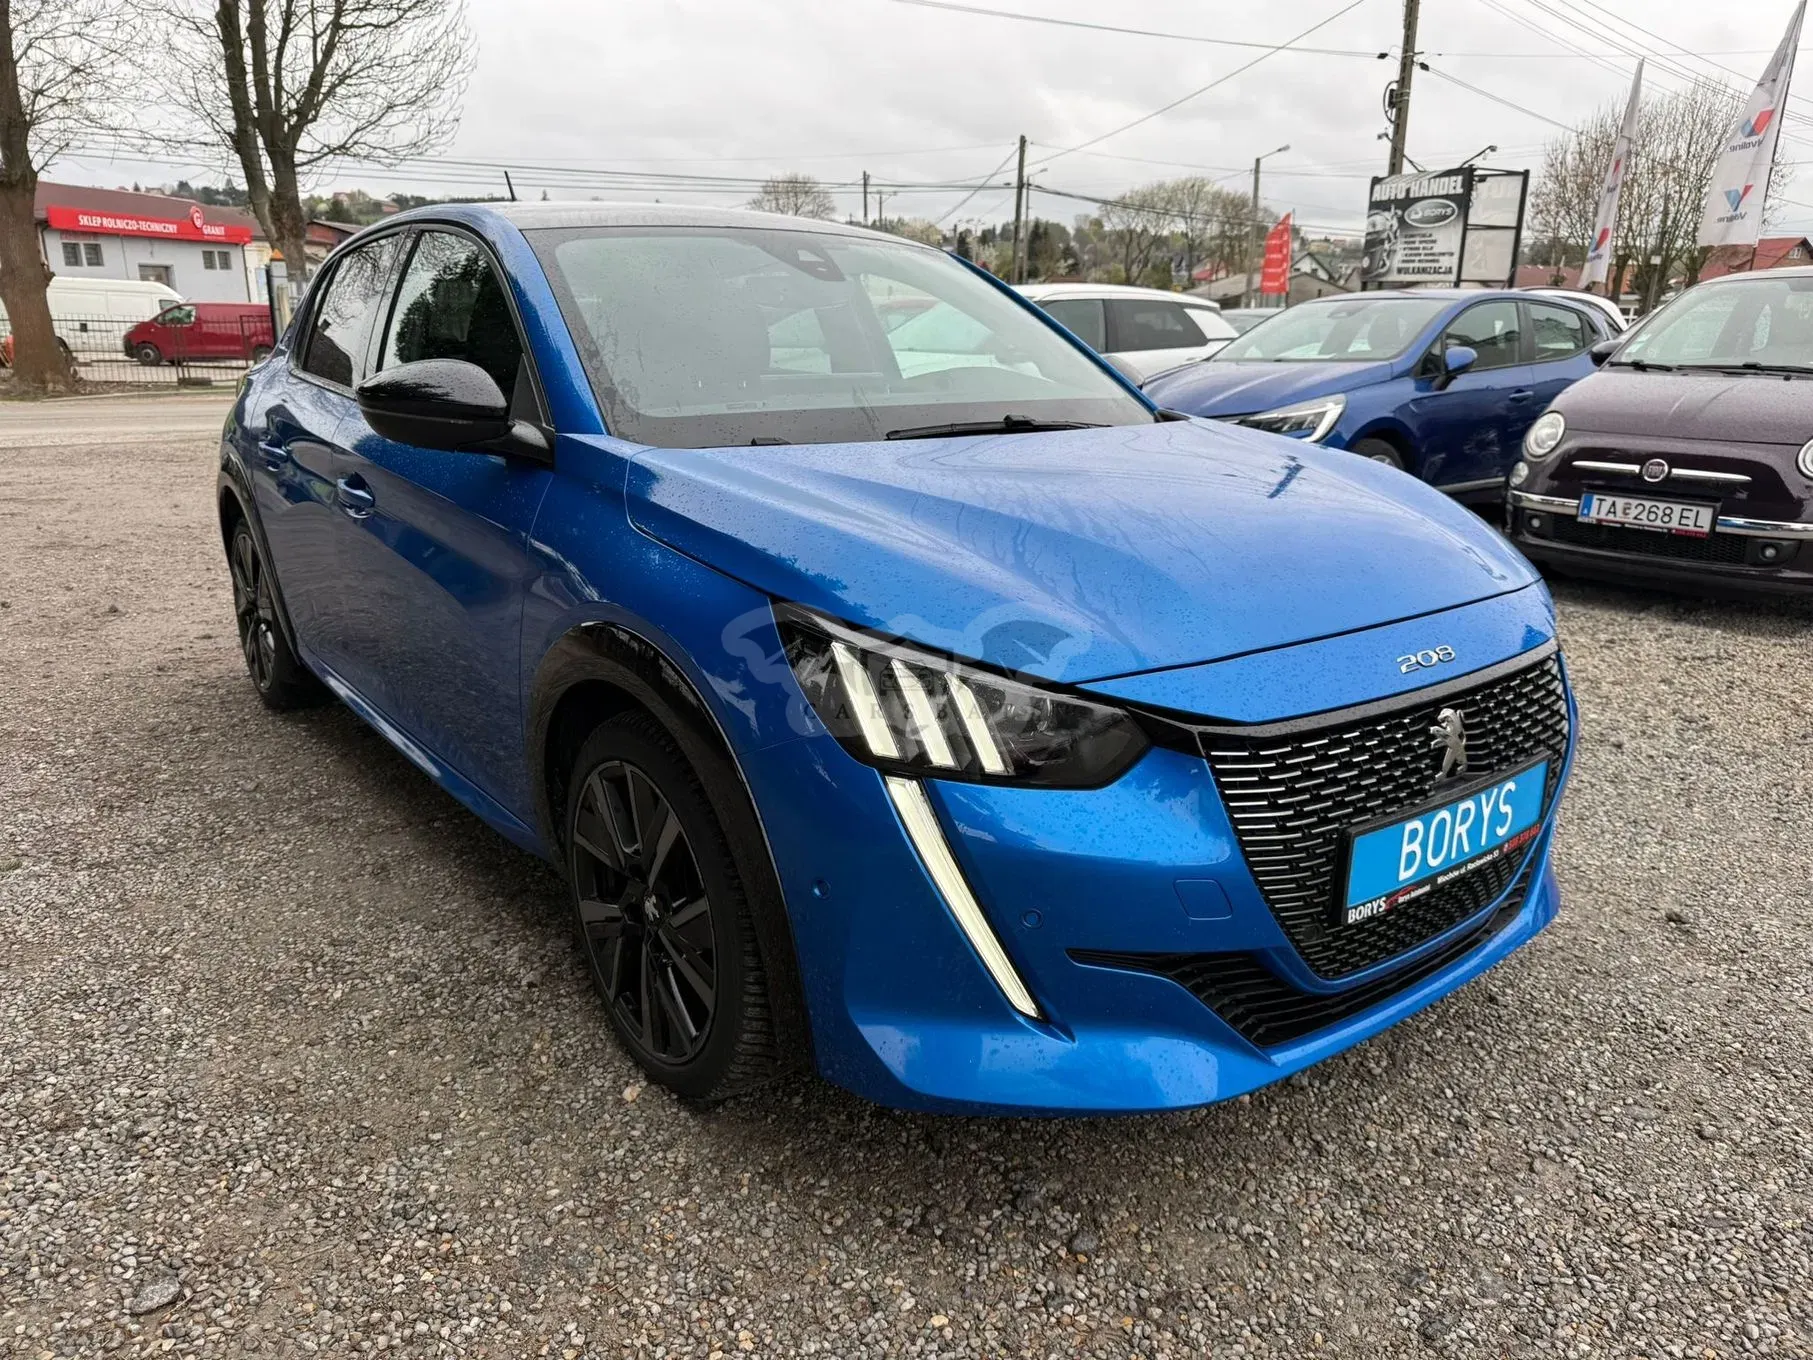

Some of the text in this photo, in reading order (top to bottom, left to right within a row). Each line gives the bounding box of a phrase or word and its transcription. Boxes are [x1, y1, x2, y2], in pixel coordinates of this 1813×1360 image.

[1371, 175, 1464, 201] AUTO HANDEL
[78, 214, 177, 233] SKLEP ROLNICZO-TECHNICZNY
[1595, 497, 1618, 518] TA
[1632, 503, 1675, 524] 268
[1677, 507, 1705, 529] EL
[1397, 645, 1456, 674] 208
[1398, 781, 1516, 882] BORYS
[1347, 897, 1387, 924] BORYS
